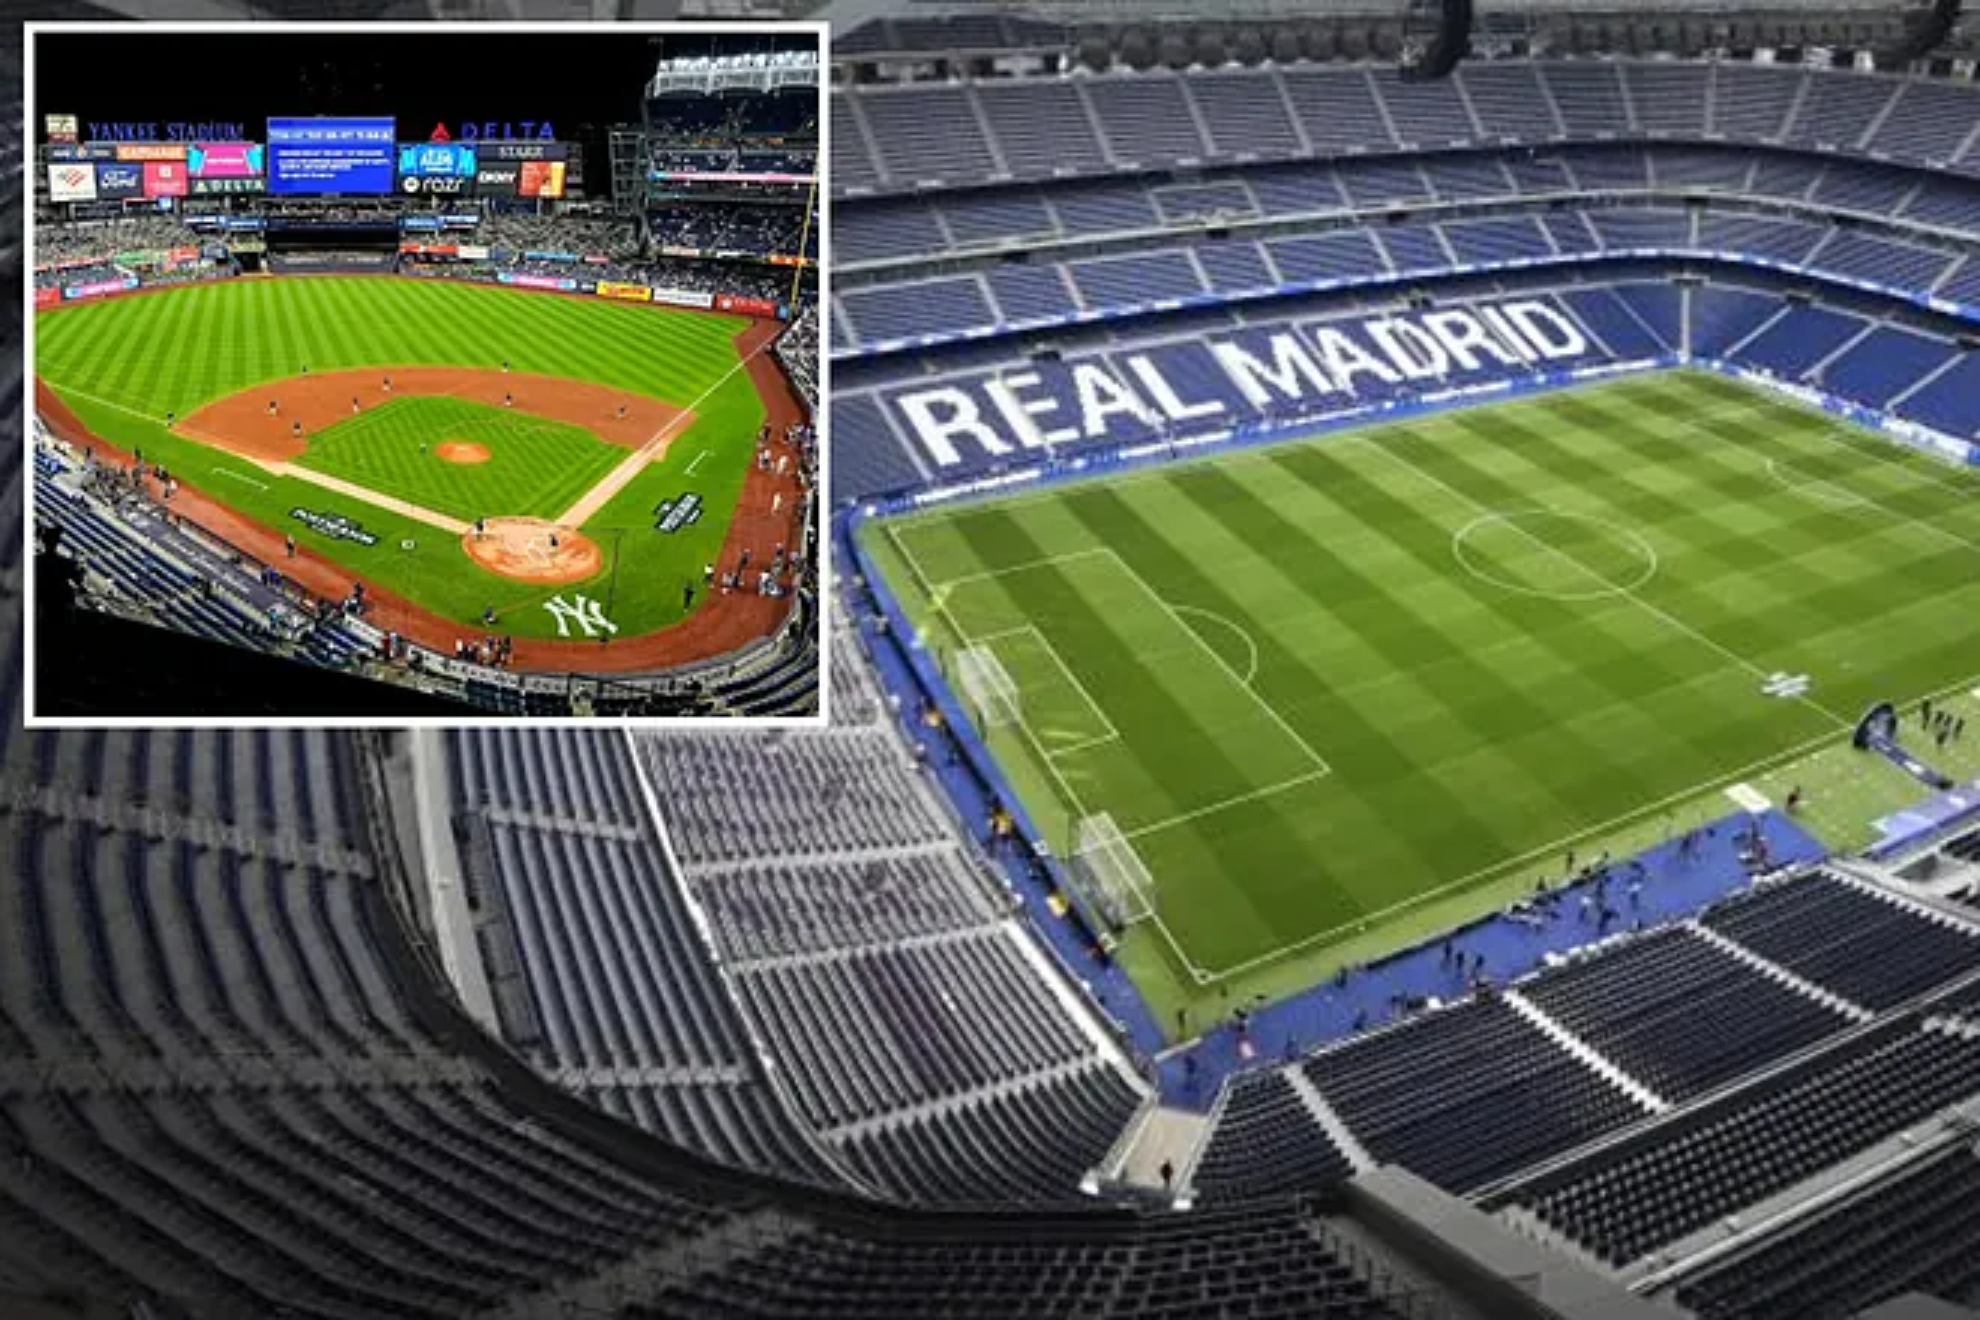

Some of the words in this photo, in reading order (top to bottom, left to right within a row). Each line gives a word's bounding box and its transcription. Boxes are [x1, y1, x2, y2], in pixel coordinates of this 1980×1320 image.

[88, 122, 157, 141] YANKEE
[166, 121, 245, 141] STADIUM
[461, 122, 556, 142] DELTA
[900, 356, 1225, 466] REAL
[1212, 300, 1586, 406] MADRID
[543, 593, 619, 637] NY
